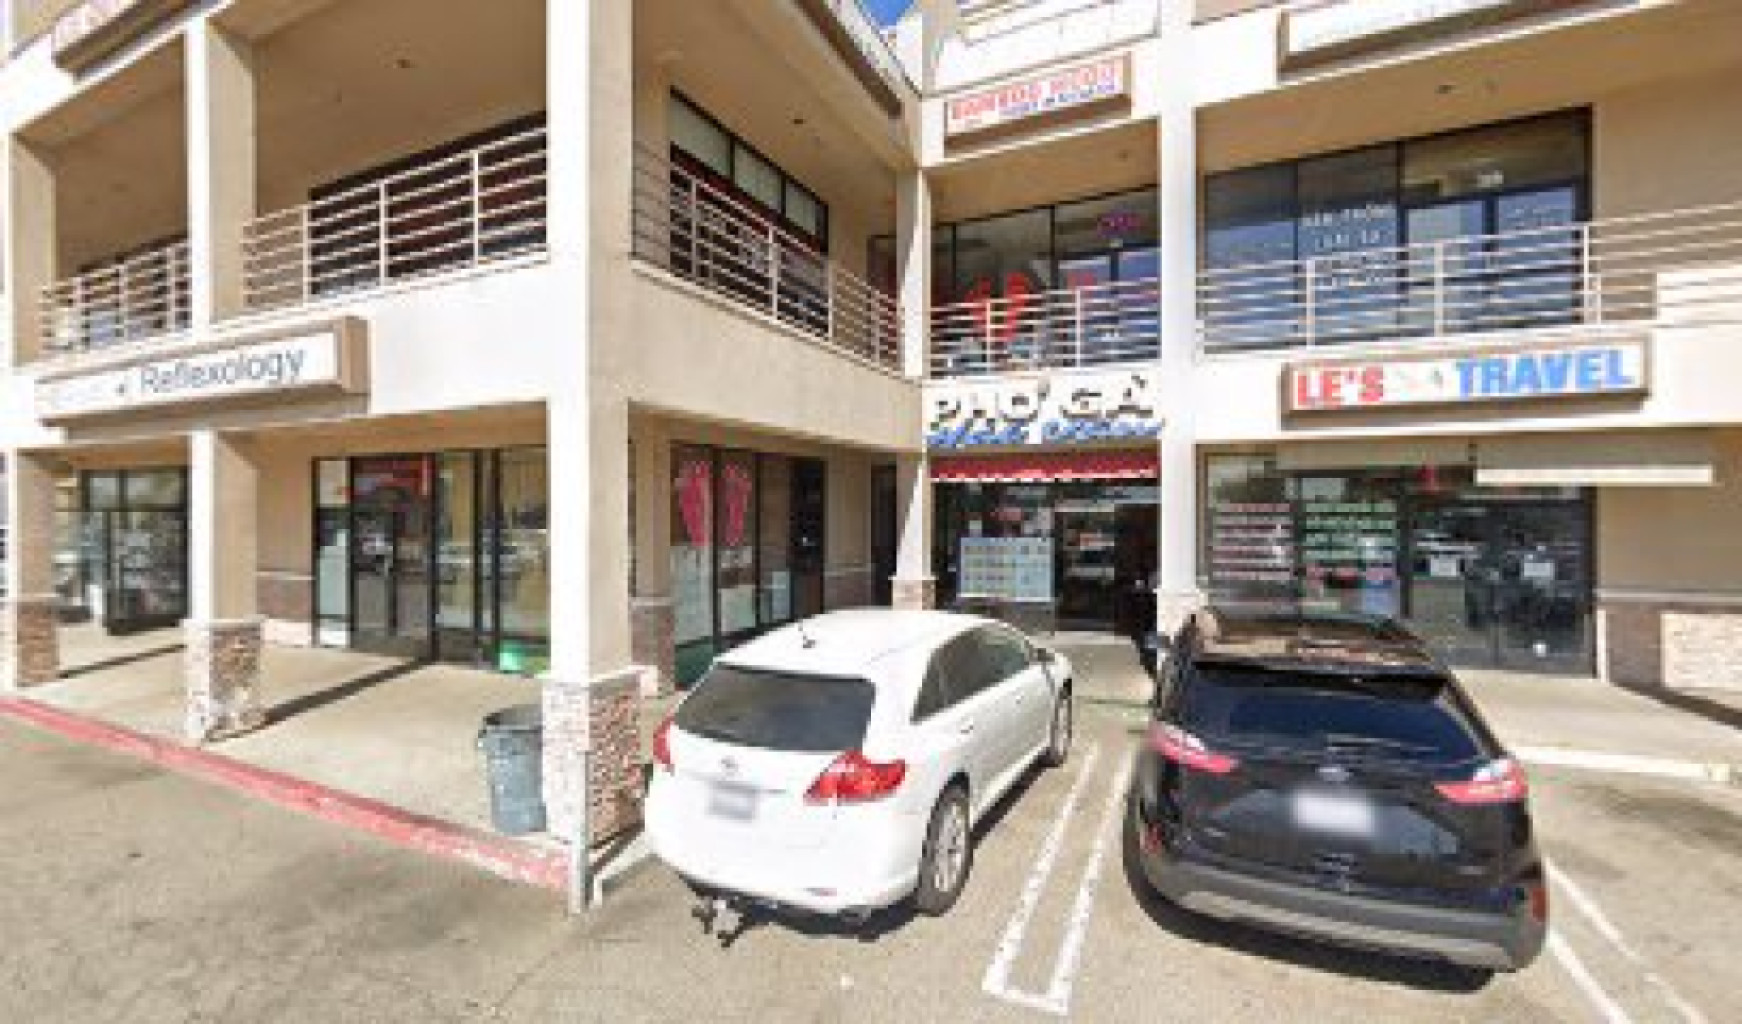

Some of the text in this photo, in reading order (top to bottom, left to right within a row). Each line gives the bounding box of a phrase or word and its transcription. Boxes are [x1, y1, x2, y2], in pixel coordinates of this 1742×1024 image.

[140, 348, 304, 393] Reflexology
[1297, 365, 1384, 407] LE'S
[1455, 348, 1633, 399] TRAVEL
